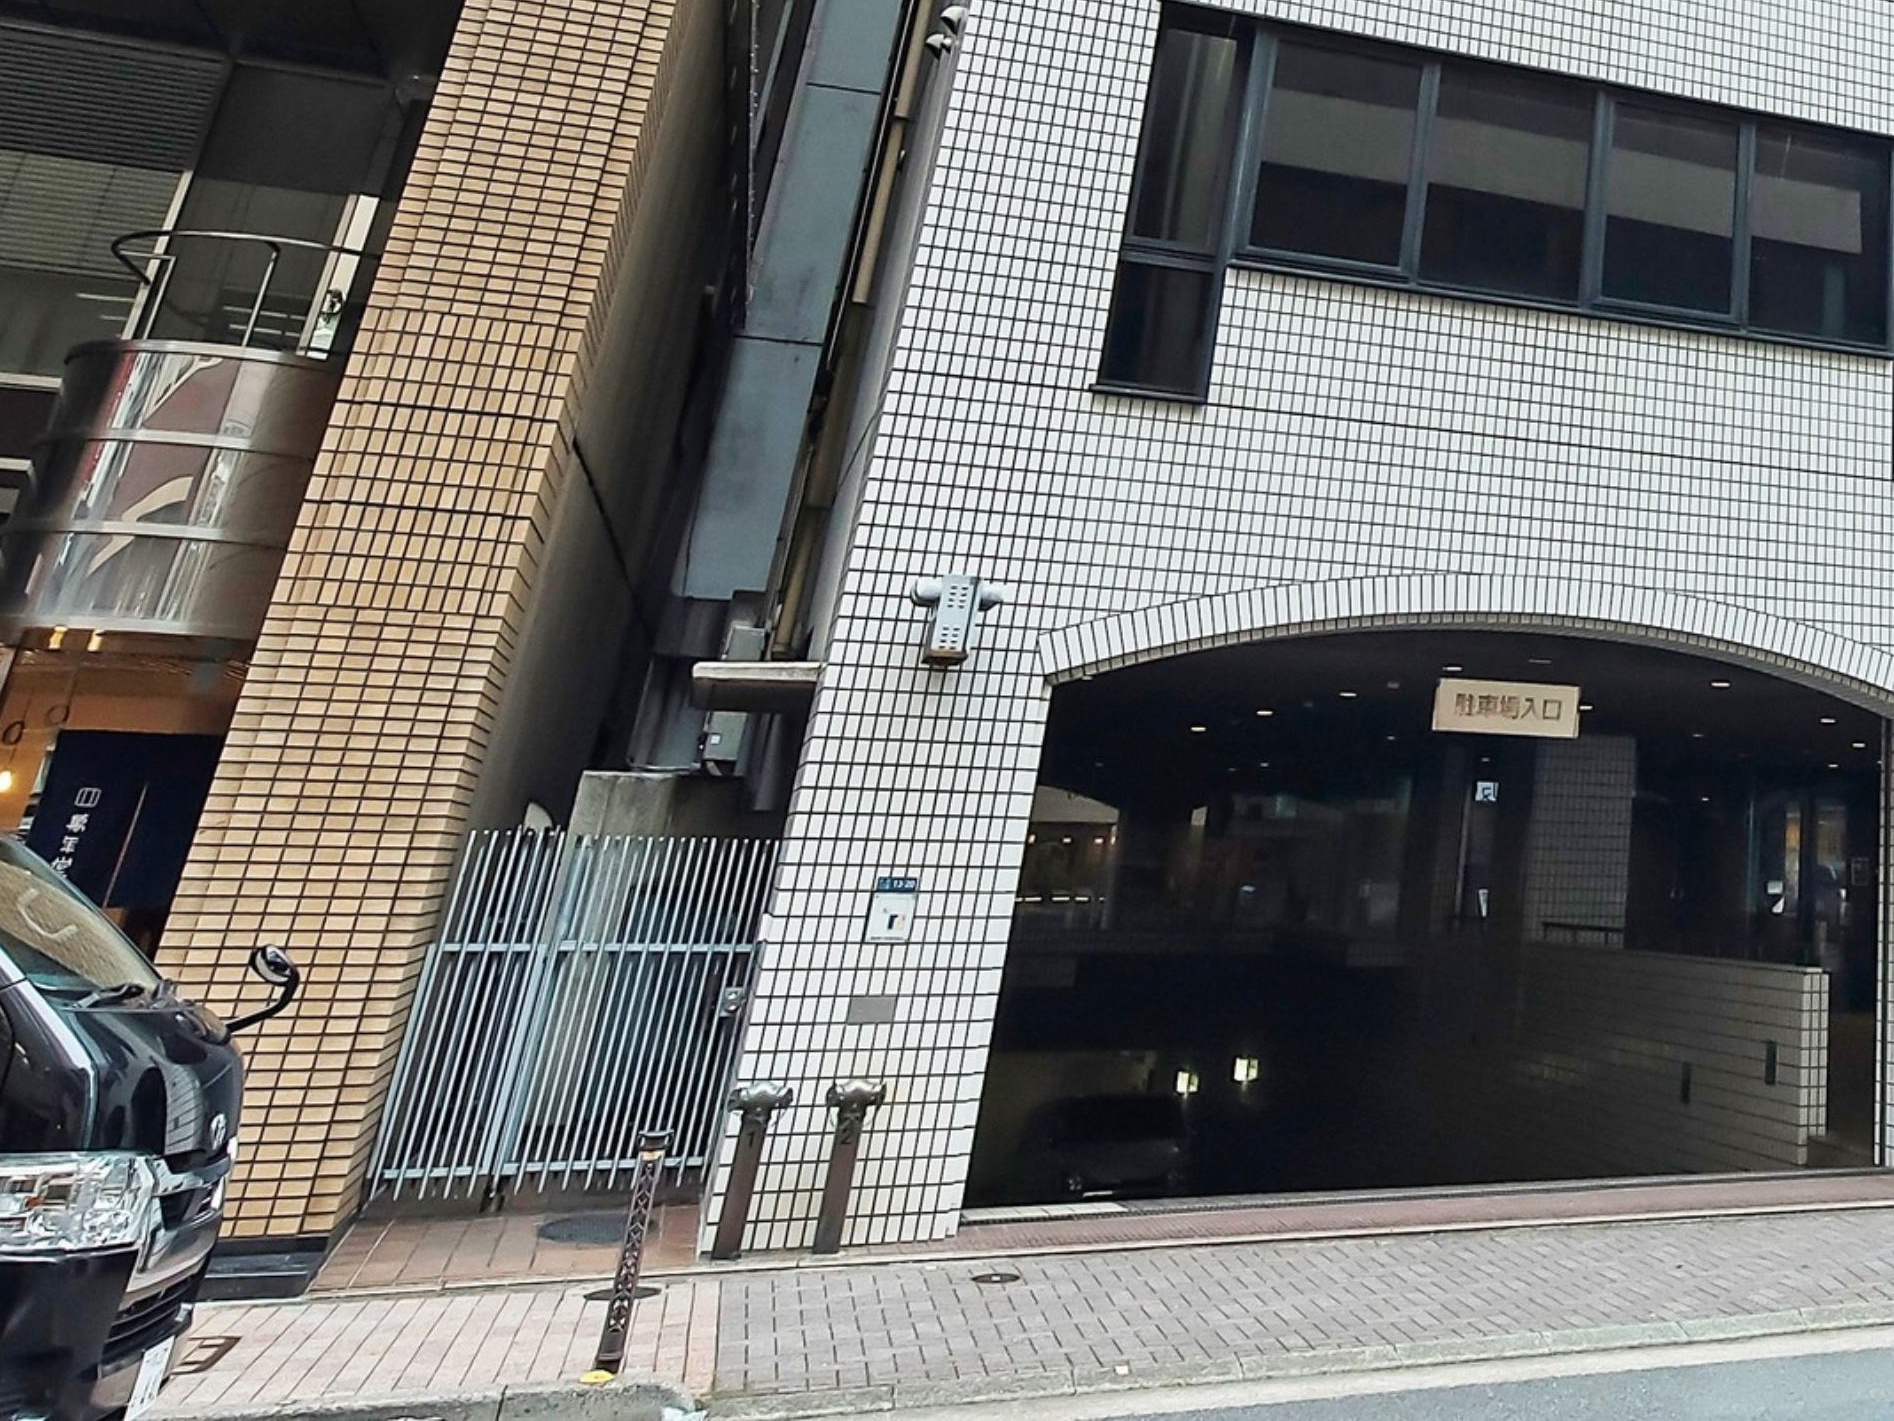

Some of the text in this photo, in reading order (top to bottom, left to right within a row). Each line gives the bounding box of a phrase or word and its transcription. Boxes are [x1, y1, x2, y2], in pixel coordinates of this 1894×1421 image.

[1455, 693, 1563, 722] 駐車場入口
